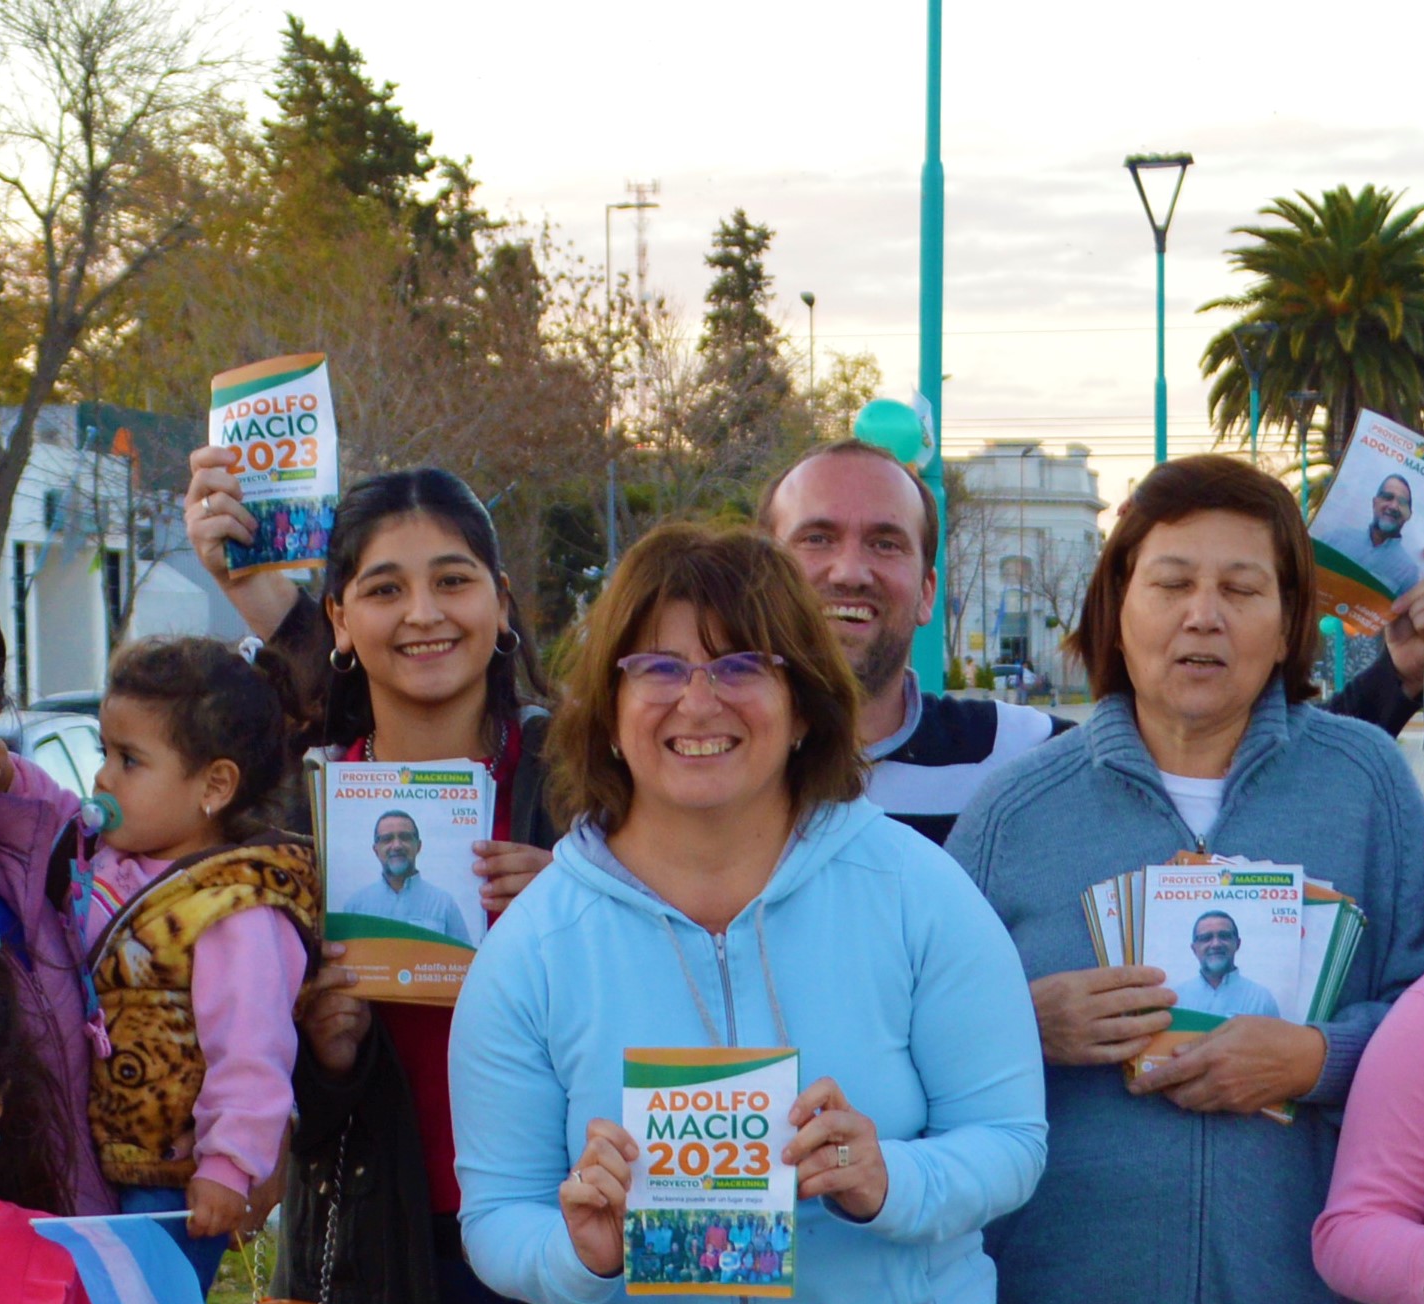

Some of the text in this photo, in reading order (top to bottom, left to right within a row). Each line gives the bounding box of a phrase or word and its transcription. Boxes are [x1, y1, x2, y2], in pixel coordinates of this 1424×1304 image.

[223, 393, 318, 423] ADOLFO
[221, 412, 318, 445] MACIO
[1371, 423, 1414, 450] PROYECTO
[226, 436, 318, 475] 2023
[342, 772, 471, 783] PROYECTO MACKENNA
[452, 807, 478, 816] LISTA
[1162, 875, 1291, 884] PROYECTO MACKENNA
[1271, 907, 1298, 916] LISTA
[646, 1091, 770, 1112] ADOLFO
[646, 1114, 769, 1140] MACIO
[647, 1141, 771, 1176] 2023
[649, 1180, 700, 1188] PROYECTO
